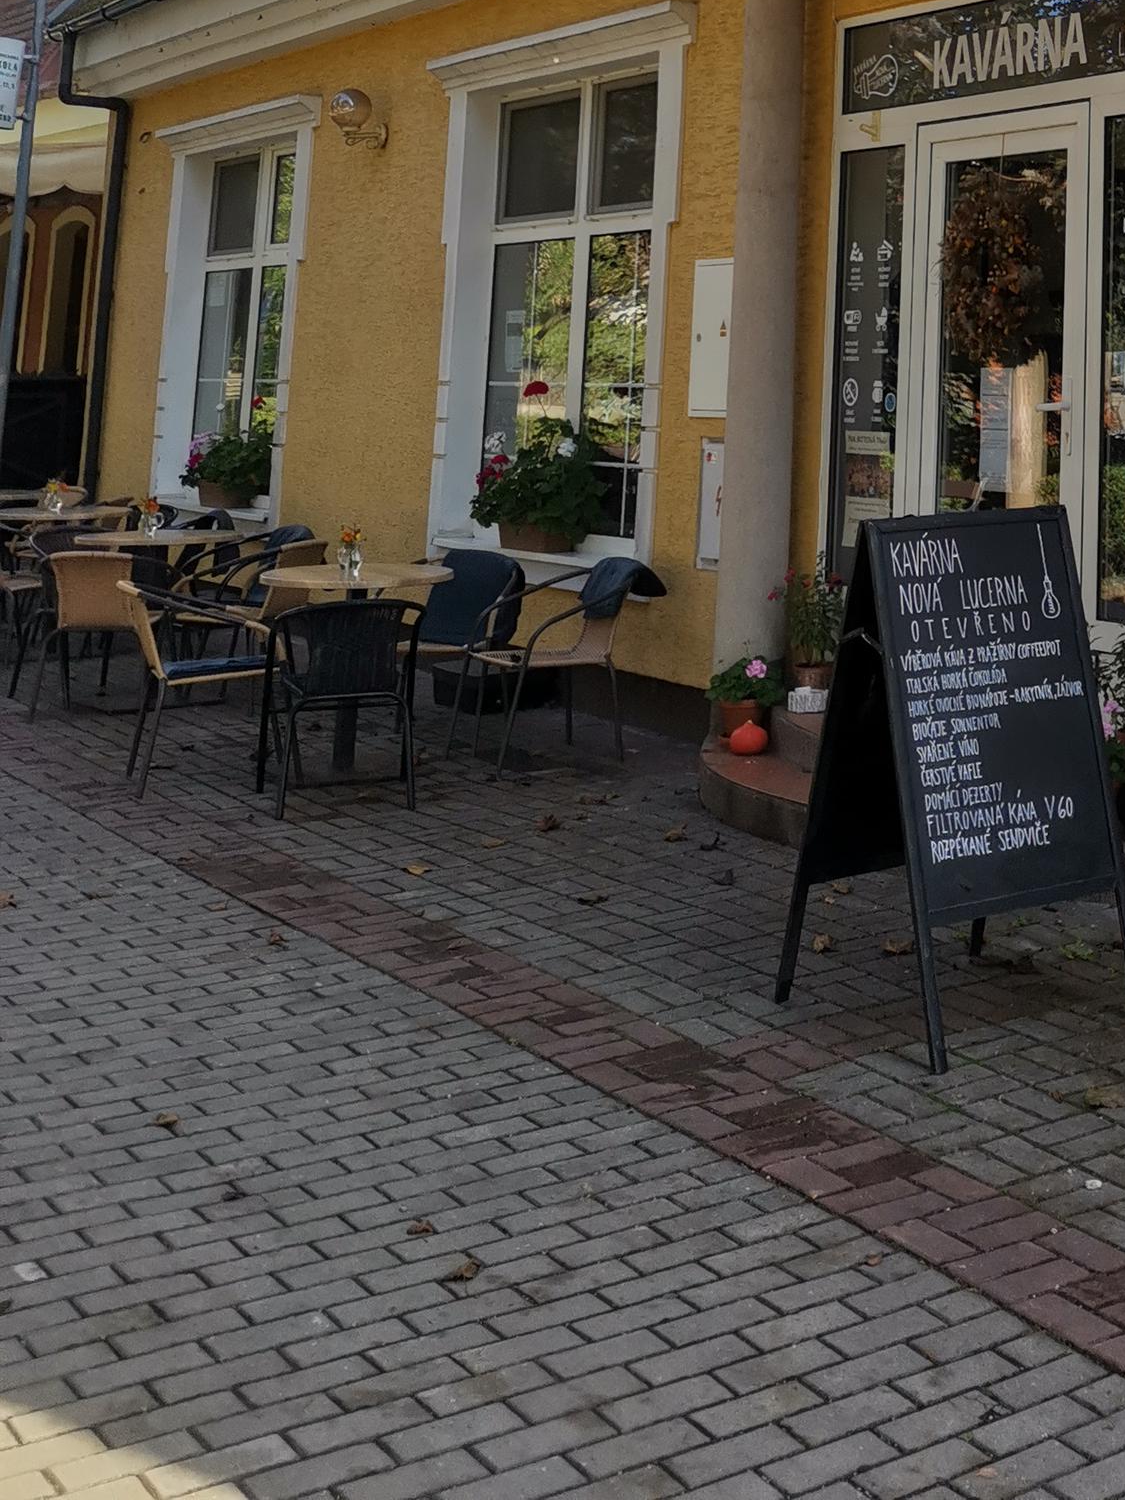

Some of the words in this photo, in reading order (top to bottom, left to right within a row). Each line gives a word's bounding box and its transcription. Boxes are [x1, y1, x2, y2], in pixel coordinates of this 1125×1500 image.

[932, 11, 1087, 89] KAVÁRNA
[890, 532, 964, 577] KAVÁRNA
[899, 577, 944, 615] NOVÁ
[959, 575, 1029, 610] LUCERNA
[911, 611, 1031, 642] OTEVŘENO
[944, 644, 967, 667] KÁVA
[967, 648, 976, 664] Z
[976, 637, 1016, 663] PRAŽÍRNY
[906, 670, 940, 694] ITALSKÁ
[940, 667, 968, 690] HORKÁ
[968, 663, 1008, 687] ČOKOLÁDA
[907, 693, 935, 718] HORKÉ
[912, 716, 947, 741] BIOČAJE
[916, 735, 957, 763] SVAŘENÉ
[957, 734, 980, 757] VÍNO
[920, 760, 957, 787] ČERSTVÉ
[957, 762, 983, 781] VAFLE
[924, 783, 961, 812] DOMÁCÍ
[962, 782, 1003, 806] DEZERTY
[926, 802, 1005, 837] FILTROVANÁ
[1007, 789, 1038, 824] KÁVA
[930, 828, 993, 864] ROZPÉKANÉ
[998, 820, 1051, 851] SENDVIČE
